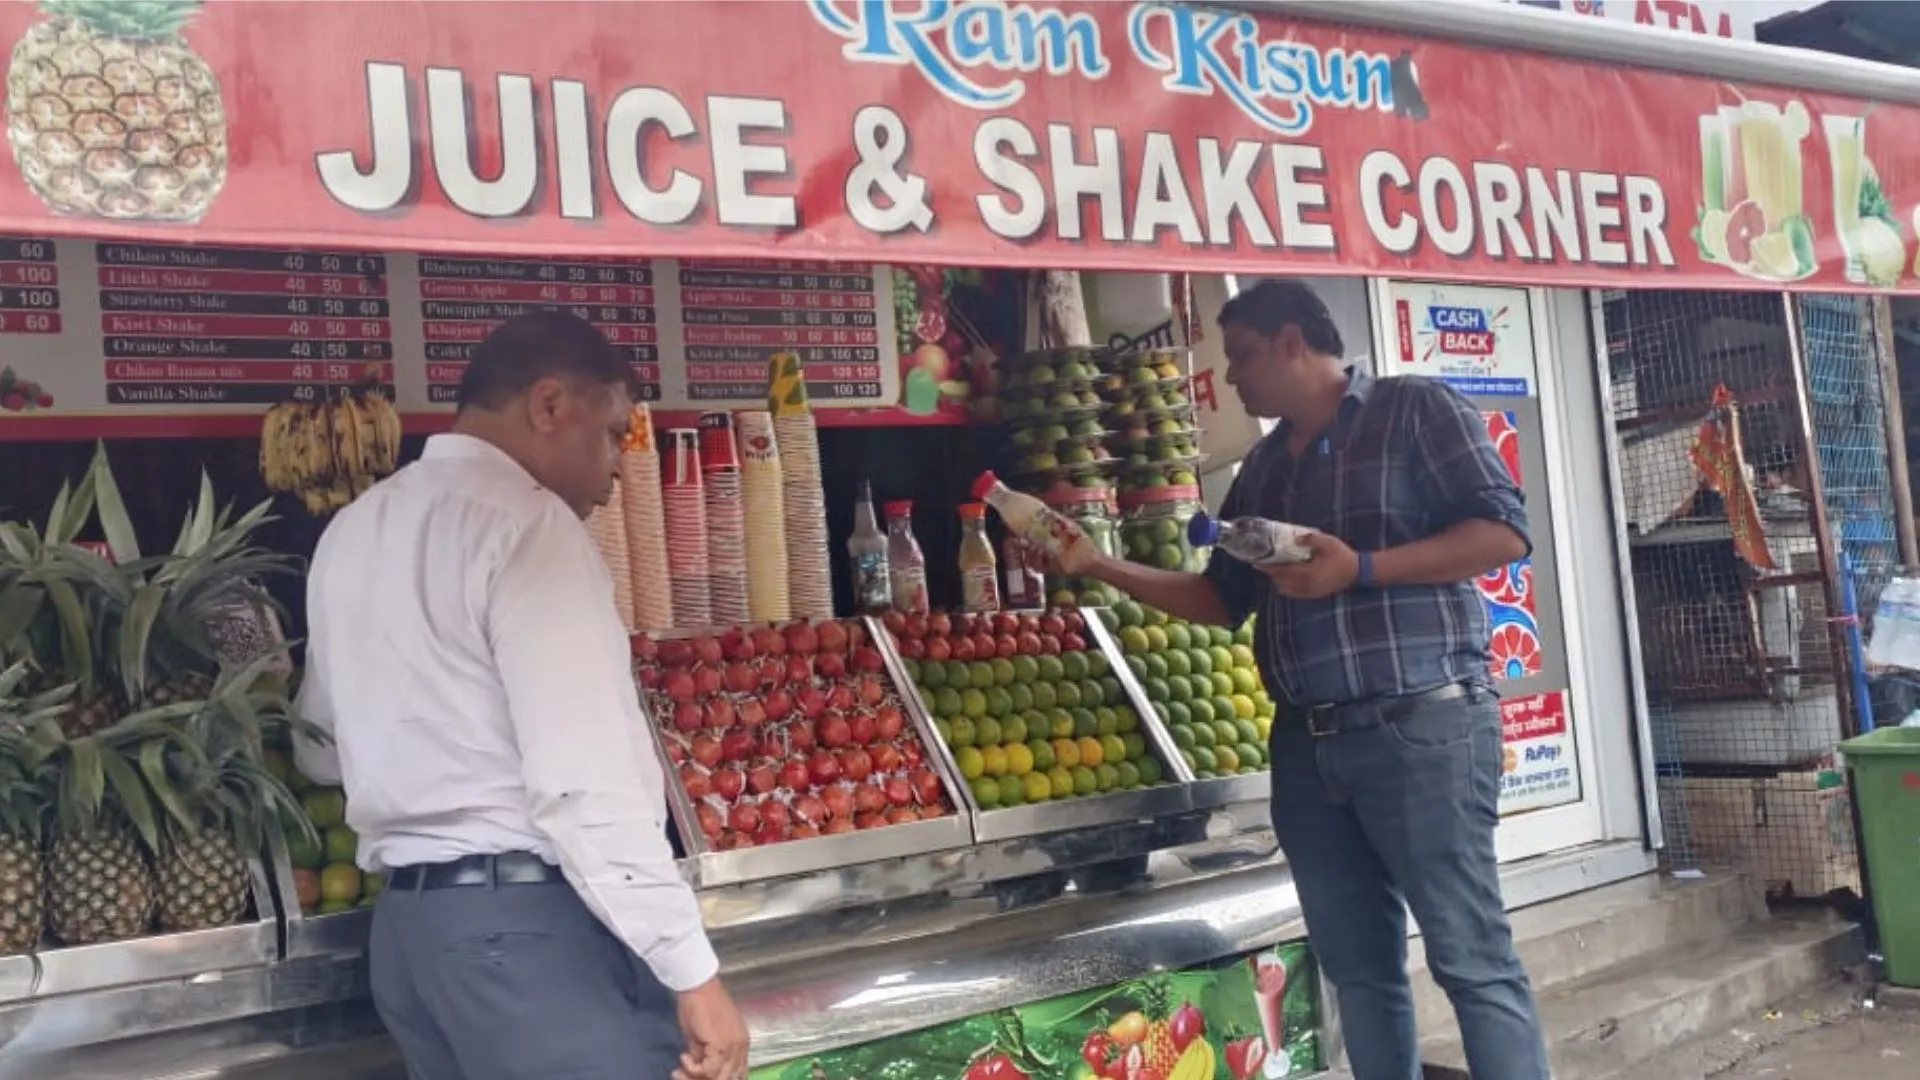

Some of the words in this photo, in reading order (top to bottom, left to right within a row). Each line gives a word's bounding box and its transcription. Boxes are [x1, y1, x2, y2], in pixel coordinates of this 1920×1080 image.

[814, 0, 1110, 108] Ram
[1127, 3, 1430, 136] Kisun
[315, 61, 797, 226] JUICE
[845, 105, 934, 234] &
[972, 116, 1335, 250] SHAKE
[1360, 150, 1675, 266] CORNER
[21, 243, 44, 257] 60
[321, 257, 340, 271] 50
[17, 266, 51, 282] 100
[628, 270, 644, 282] 70
[286, 278, 306, 291] 40
[19, 290, 52, 306] 100
[288, 300, 308, 314] 40
[324, 301, 344, 316] 50
[360, 302, 380, 316] 60
[426, 302, 492, 320] Pineapple
[632, 308, 647, 321] 70
[853, 312, 873, 325] 100
[1436, 310, 1479, 328] CASH
[289, 321, 309, 335] 40
[326, 323, 346, 337] 50
[362, 323, 381, 337] 60
[633, 328, 649, 341] 70
[179, 341, 228, 355] Shake
[291, 342, 311, 356] 40
[327, 344, 348, 358] 50
[1445, 333, 1489, 351] BACK
[292, 365, 313, 379] 40
[329, 366, 349, 380] 50
[178, 387, 228, 402] Shake
[294, 386, 315, 399] 40
[833, 384, 854, 397] 100
[1526, 744, 1557, 763] RuPay
